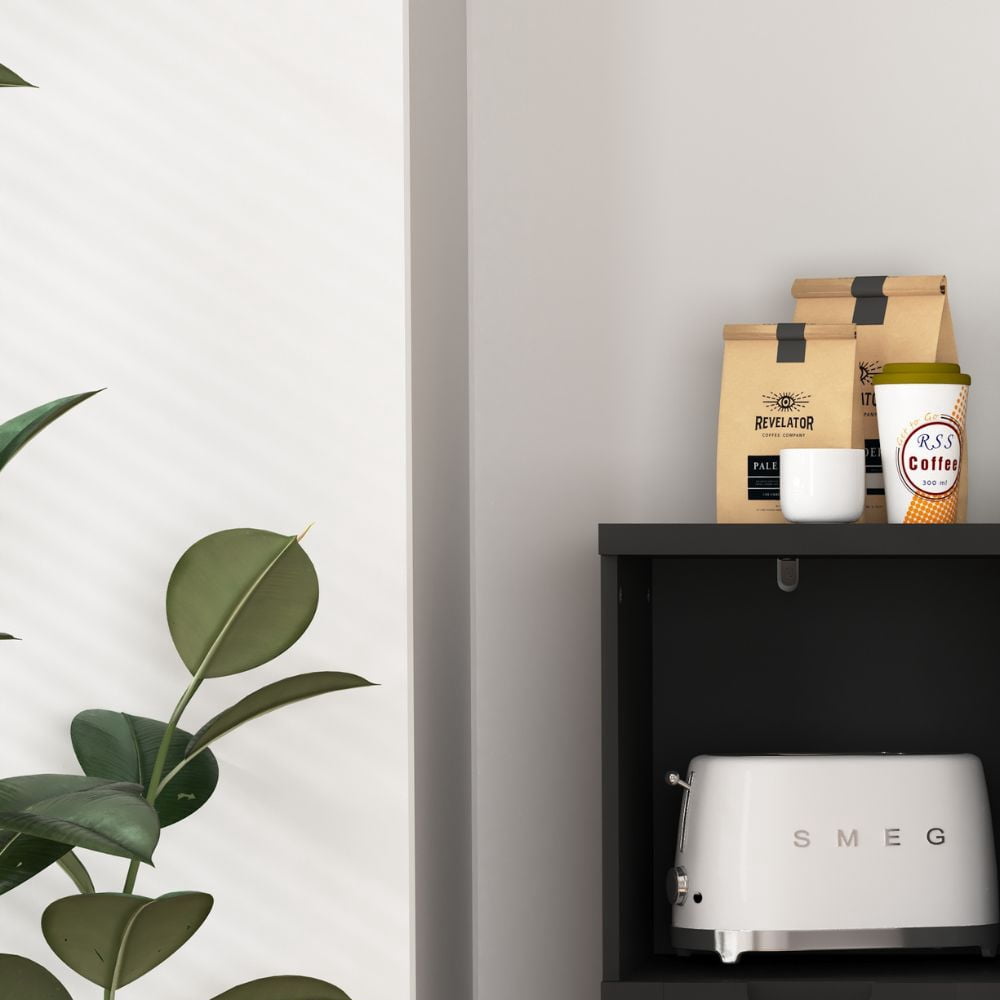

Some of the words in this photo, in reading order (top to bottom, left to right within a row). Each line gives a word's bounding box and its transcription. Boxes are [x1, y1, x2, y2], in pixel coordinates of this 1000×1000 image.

[755, 415, 815, 431] REVELATOR
[917, 433, 954, 451] RSS
[753, 461, 778, 470] PALE
[909, 456, 958, 471] Coffee
[793, 827, 945, 848] SMEG
